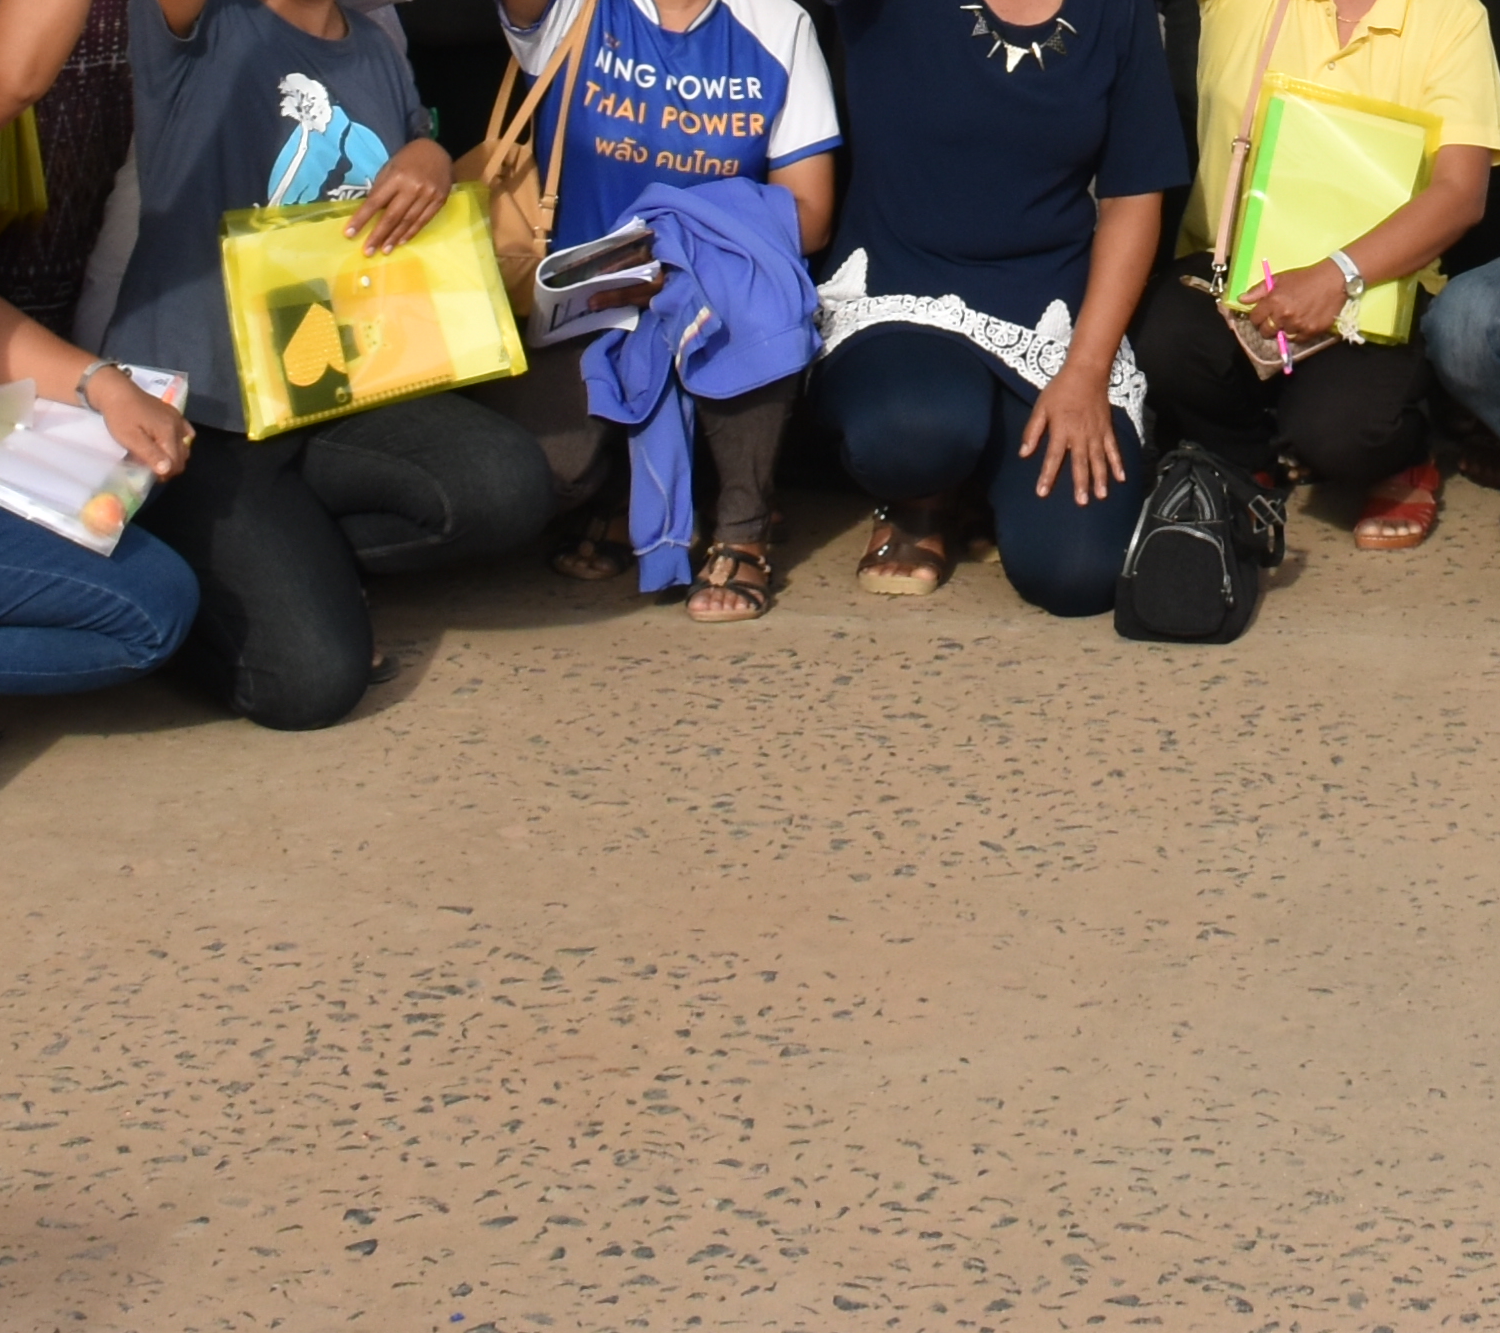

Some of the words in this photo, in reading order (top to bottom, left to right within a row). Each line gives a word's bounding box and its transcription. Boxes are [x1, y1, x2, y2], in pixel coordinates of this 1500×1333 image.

[666, 75, 763, 100] POWER
[584, 81, 647, 124] THAI
[661, 106, 765, 137] POWER
[595, 136, 648, 164] พลัง
[655, 149, 740, 177] คนไทย
